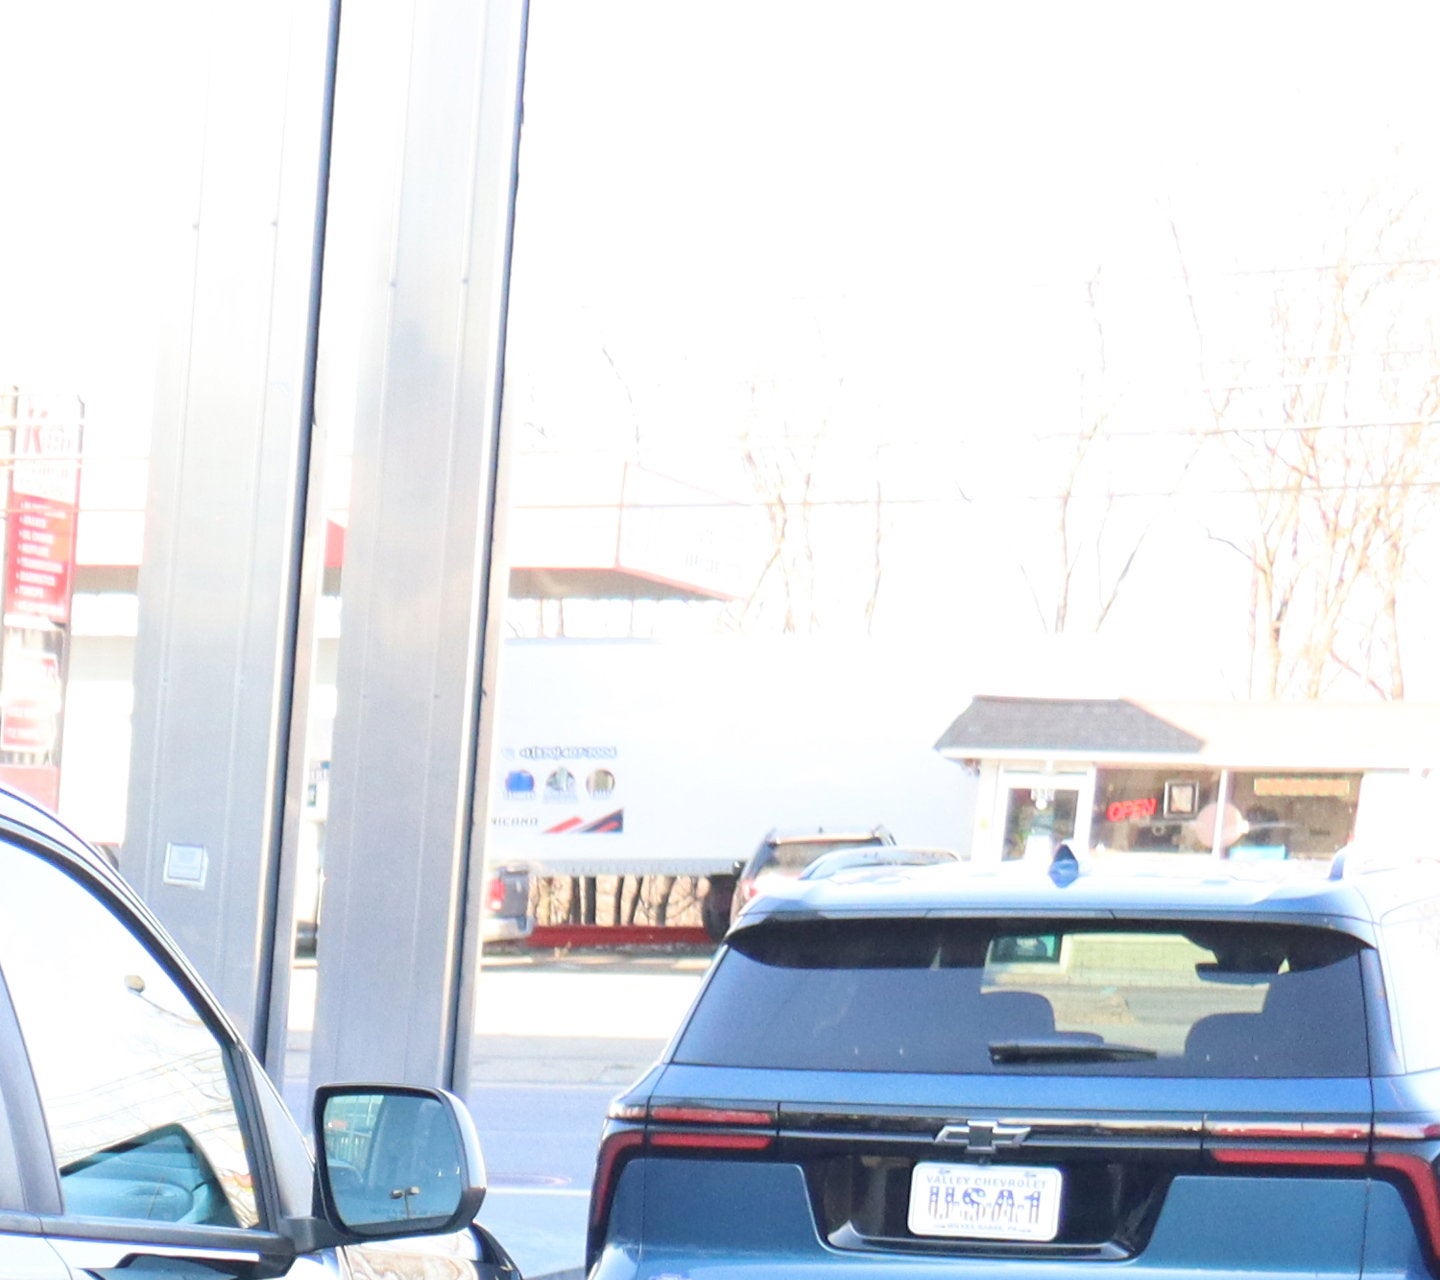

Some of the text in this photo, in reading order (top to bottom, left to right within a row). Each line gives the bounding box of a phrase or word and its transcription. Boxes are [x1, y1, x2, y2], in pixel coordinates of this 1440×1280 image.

[1106, 797, 1158, 822] OPEN
[926, 1175, 1047, 1188] VALLEY CHEVROLET
